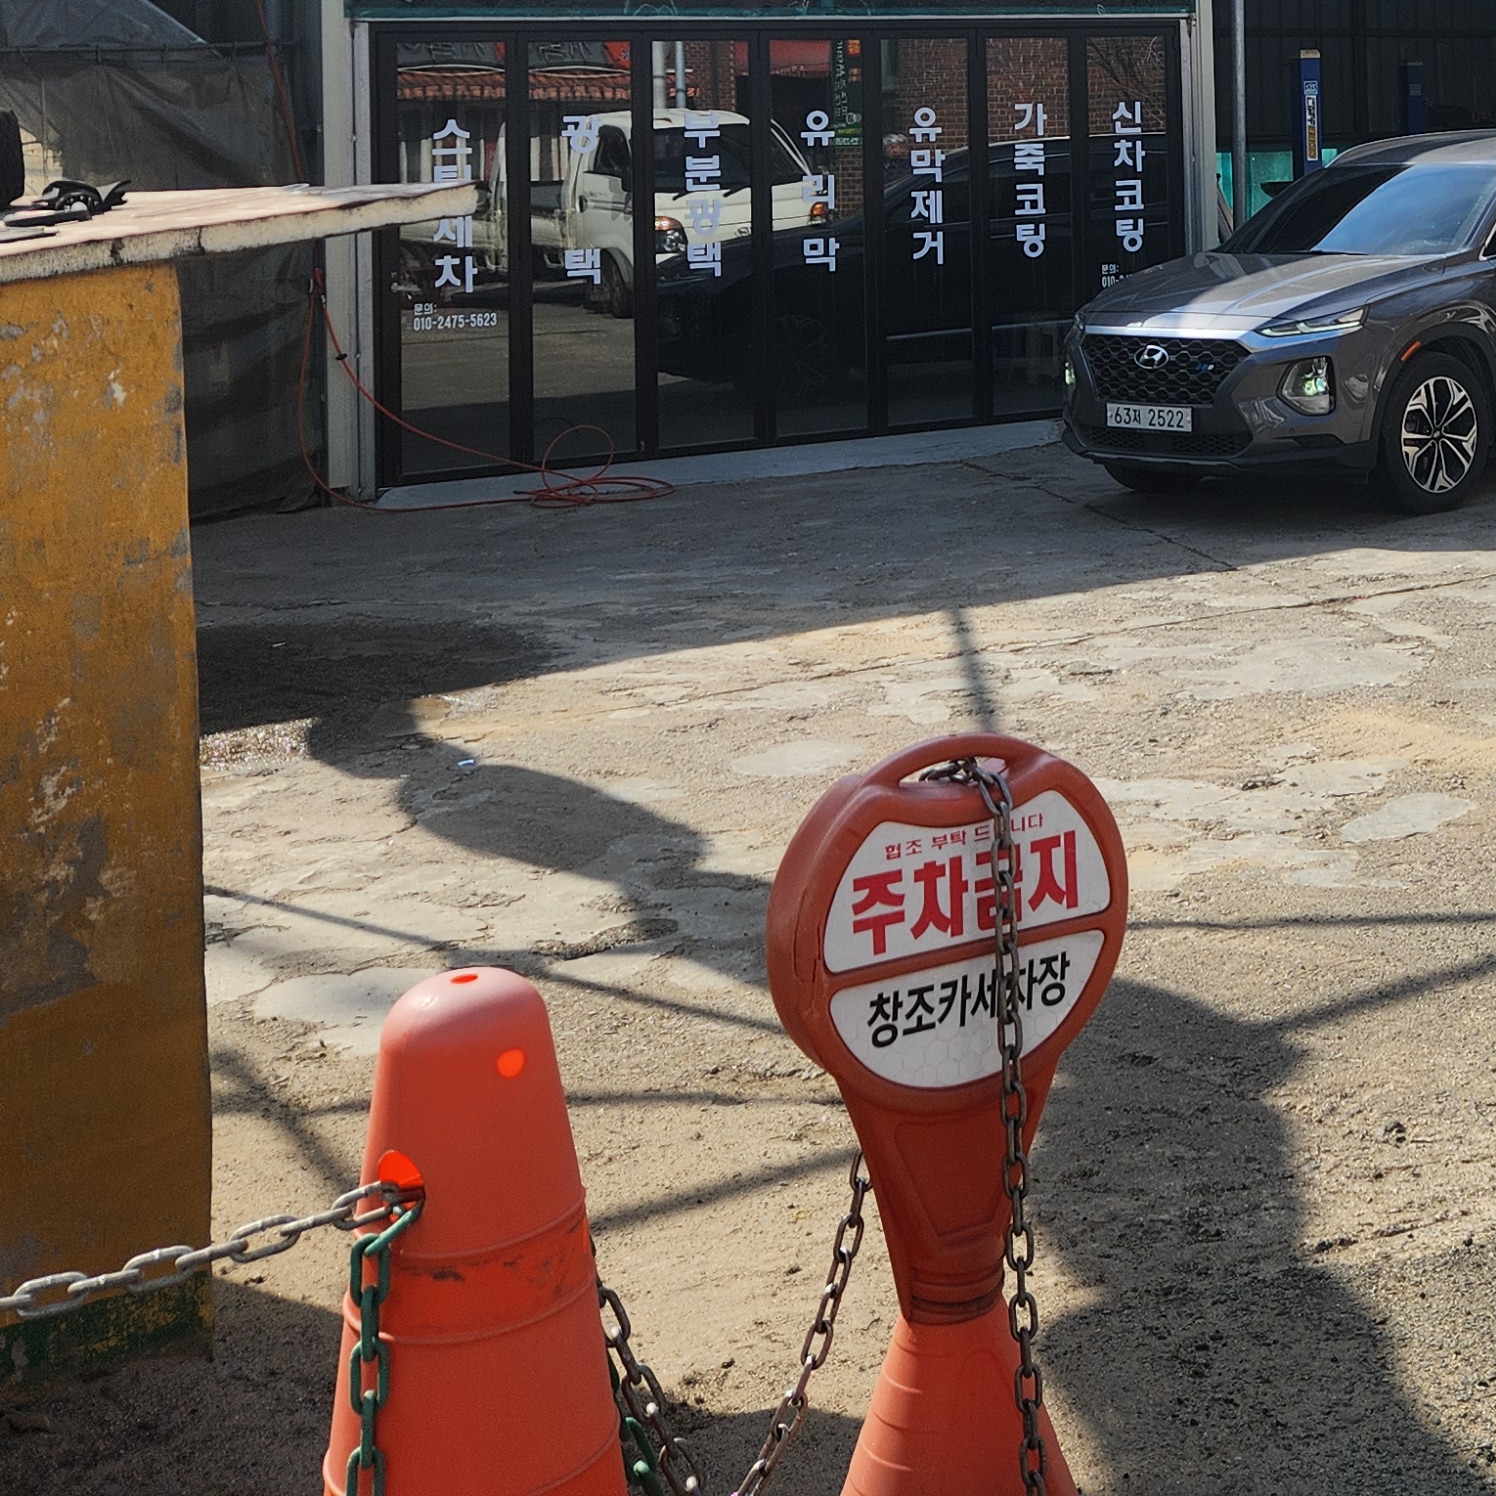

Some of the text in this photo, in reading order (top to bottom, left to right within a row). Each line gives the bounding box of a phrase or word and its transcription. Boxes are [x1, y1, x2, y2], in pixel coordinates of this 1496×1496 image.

[684, 112, 725, 277] 부분광택
[800, 110, 839, 272] 유리막
[909, 107, 946, 265] 유막제거
[1013, 103, 1047, 258] 가죽코팅
[1112, 101, 1146, 252] 신차코팅
[413, 313, 497, 331] 010-2475-5623
[1114, 407, 1184, 429] 63저 2522
[885, 813, 1044, 860] 협조 부탁 드니다
